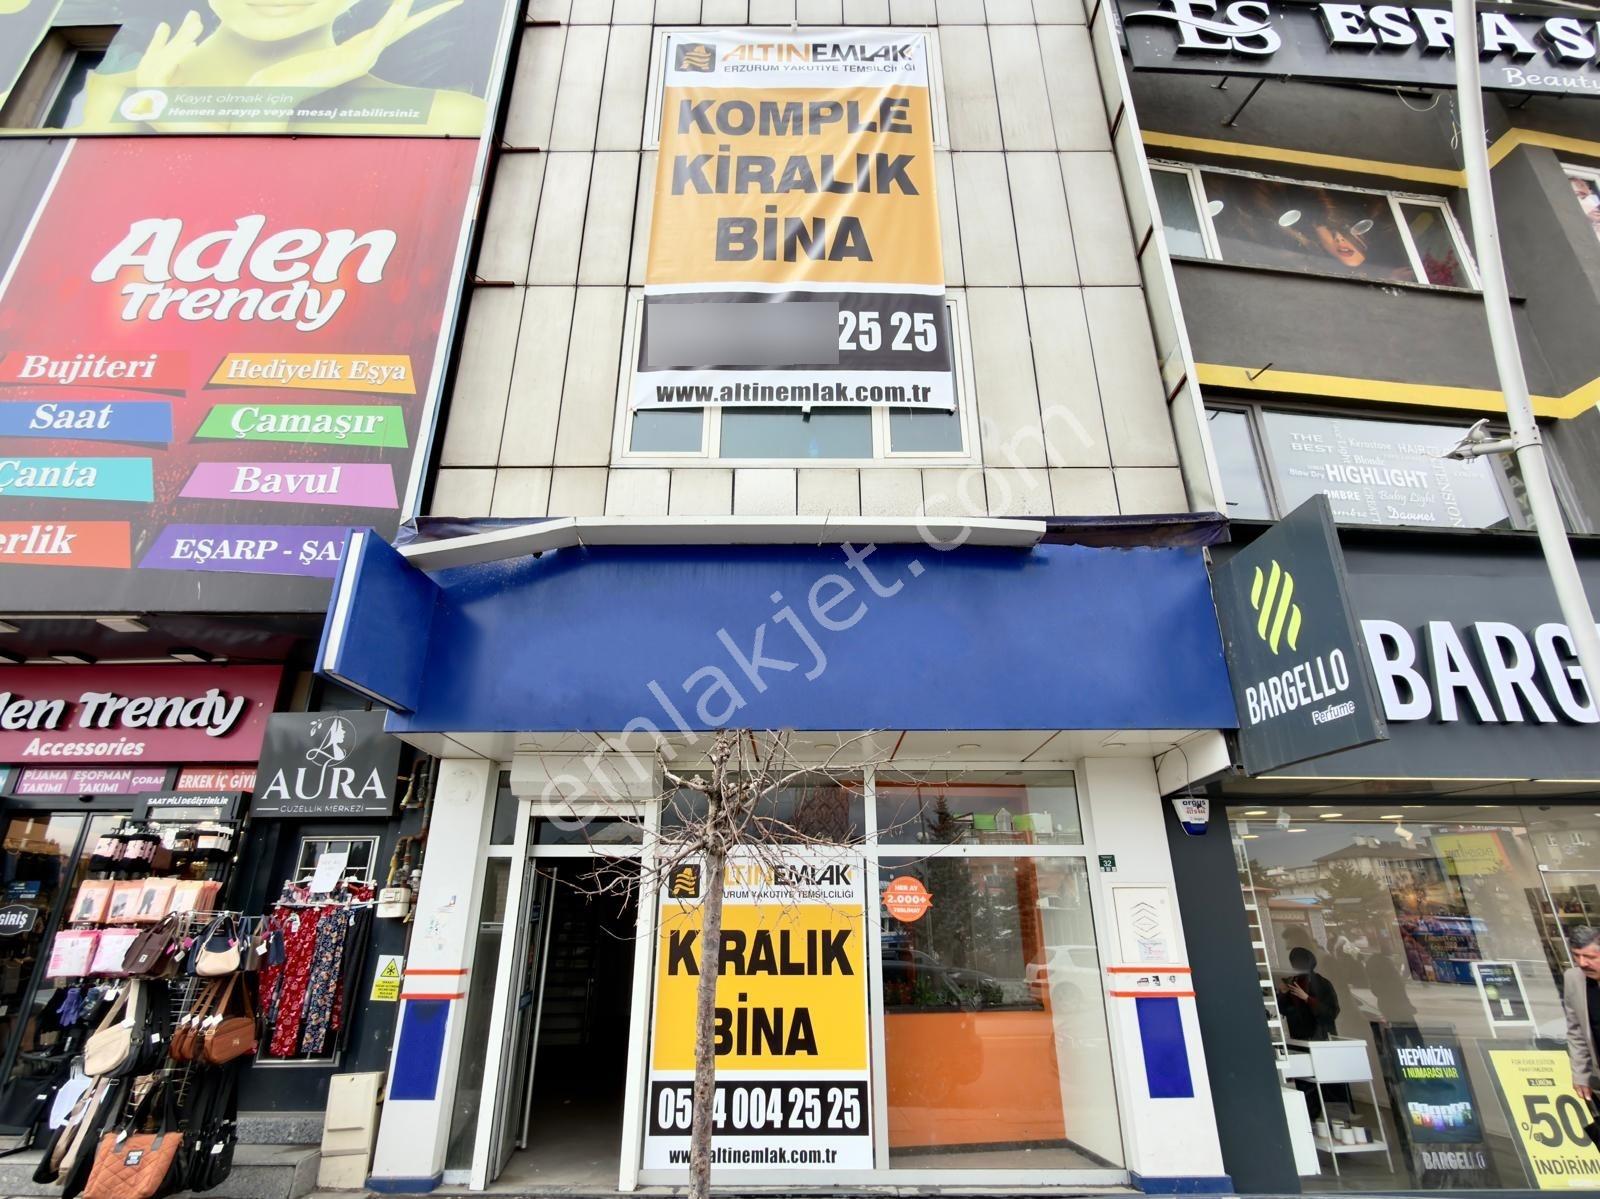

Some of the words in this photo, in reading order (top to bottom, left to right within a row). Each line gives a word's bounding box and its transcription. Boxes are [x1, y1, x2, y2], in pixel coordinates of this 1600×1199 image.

[1545, 17, 1600, 60] S
[722, 43, 912, 63] ALTINEMLAK
[724, 65, 779, 73] ERZURUM
[174, 93, 211, 105] Kayıt
[215, 93, 263, 104] olmak
[266, 93, 293, 106] için
[167, 107, 216, 118] Hemen
[217, 109, 261, 119] arayıp
[262, 109, 294, 118] veya
[296, 107, 338, 119] mesaj
[338, 107, 421, 119] atabilirsiniz
[677, 97, 913, 137] KOMPLE
[671, 143, 920, 196] KİRALIK
[715, 204, 874, 263] BİNA
[91, 214, 397, 283] Aden
[120, 281, 347, 332] Trendy
[838, 310, 882, 351] 25
[890, 311, 938, 352] 25
[17, 354, 158, 384] Bujiteri
[226, 359, 342, 384] Hediyelik
[347, 361, 407, 385] Eşya
[656, 382, 932, 404] www.altinemlak.com.tr
[28, 403, 113, 430] Saat
[230, 406, 384, 439] Çamaşır
[1290, 433, 1322, 443] THE
[1292, 443, 1333, 453] BEST
[0, 460, 98, 494] Çanta
[230, 466, 341, 495] Bavul
[1325, 464, 1428, 489] HIGHLIGHT
[170, 539, 278, 564] EŞARP
[299, 540, 345, 565] ŞA
[1360, 618, 1600, 724] BARG
[1245, 648, 1350, 726] BARGELLO
[79, 688, 245, 737] Trendy
[1312, 700, 1356, 726] Perfume
[21, 737, 146, 757] Accessories
[23, 769, 67, 780] PİJAMA
[73, 770, 131, 782] EŞOFMAN
[178, 774, 215, 788] ERKEK
[215, 772, 229, 791] İÇ
[261, 766, 387, 800] AURA
[22, 783, 63, 793] TAKIMI
[79, 783, 119, 793] TAKIMI
[887, 895, 926, 904] 2.000+
[0, 911, 28, 929] GİRİŞ
[668, 929, 854, 976] KRALIK
[1397, 1046, 1455, 1066] HEPİMİZİN
[658, 1087, 726, 1129] 054
[732, 1087, 783, 1129] 004
[788, 1087, 822, 1129] 25
[827, 1087, 861, 1129] 25
